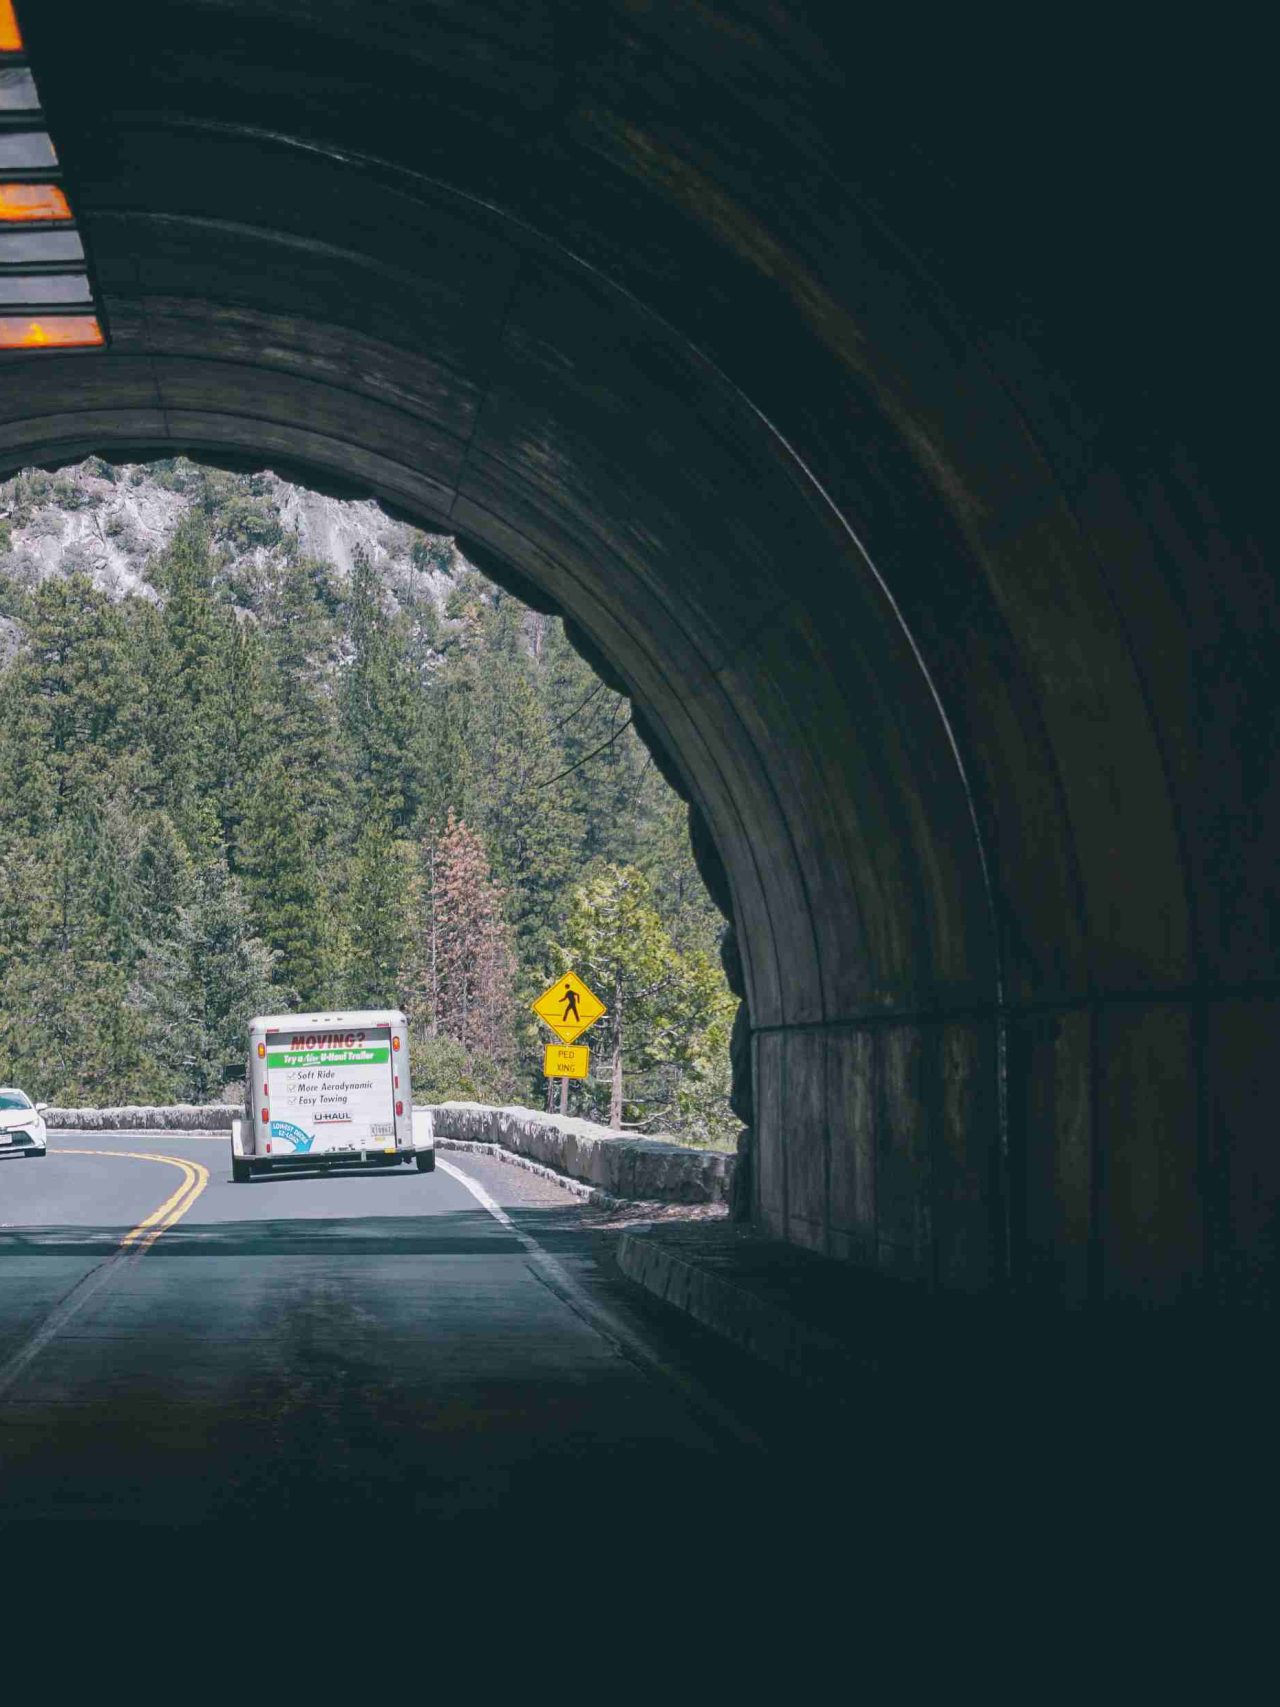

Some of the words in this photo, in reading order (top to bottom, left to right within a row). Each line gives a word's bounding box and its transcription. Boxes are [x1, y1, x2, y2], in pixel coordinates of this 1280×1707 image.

[290, 1032, 366, 1050] MOVING?
[284, 1055, 297, 1065] Try
[320, 1052, 346, 1062] U-Haul
[347, 1051, 374, 1061] Trailer
[558, 1050, 575, 1059] PED
[557, 1064, 575, 1072] XING
[297, 1071, 314, 1080] Soft
[317, 1070, 335, 1079] Ride
[297, 1083, 318, 1092] More
[321, 1080, 373, 1091] Aerodynamic
[298, 1096, 317, 1106] Easy
[320, 1094, 348, 1104] Towing
[314, 1112, 352, 1121] U-HAUL
